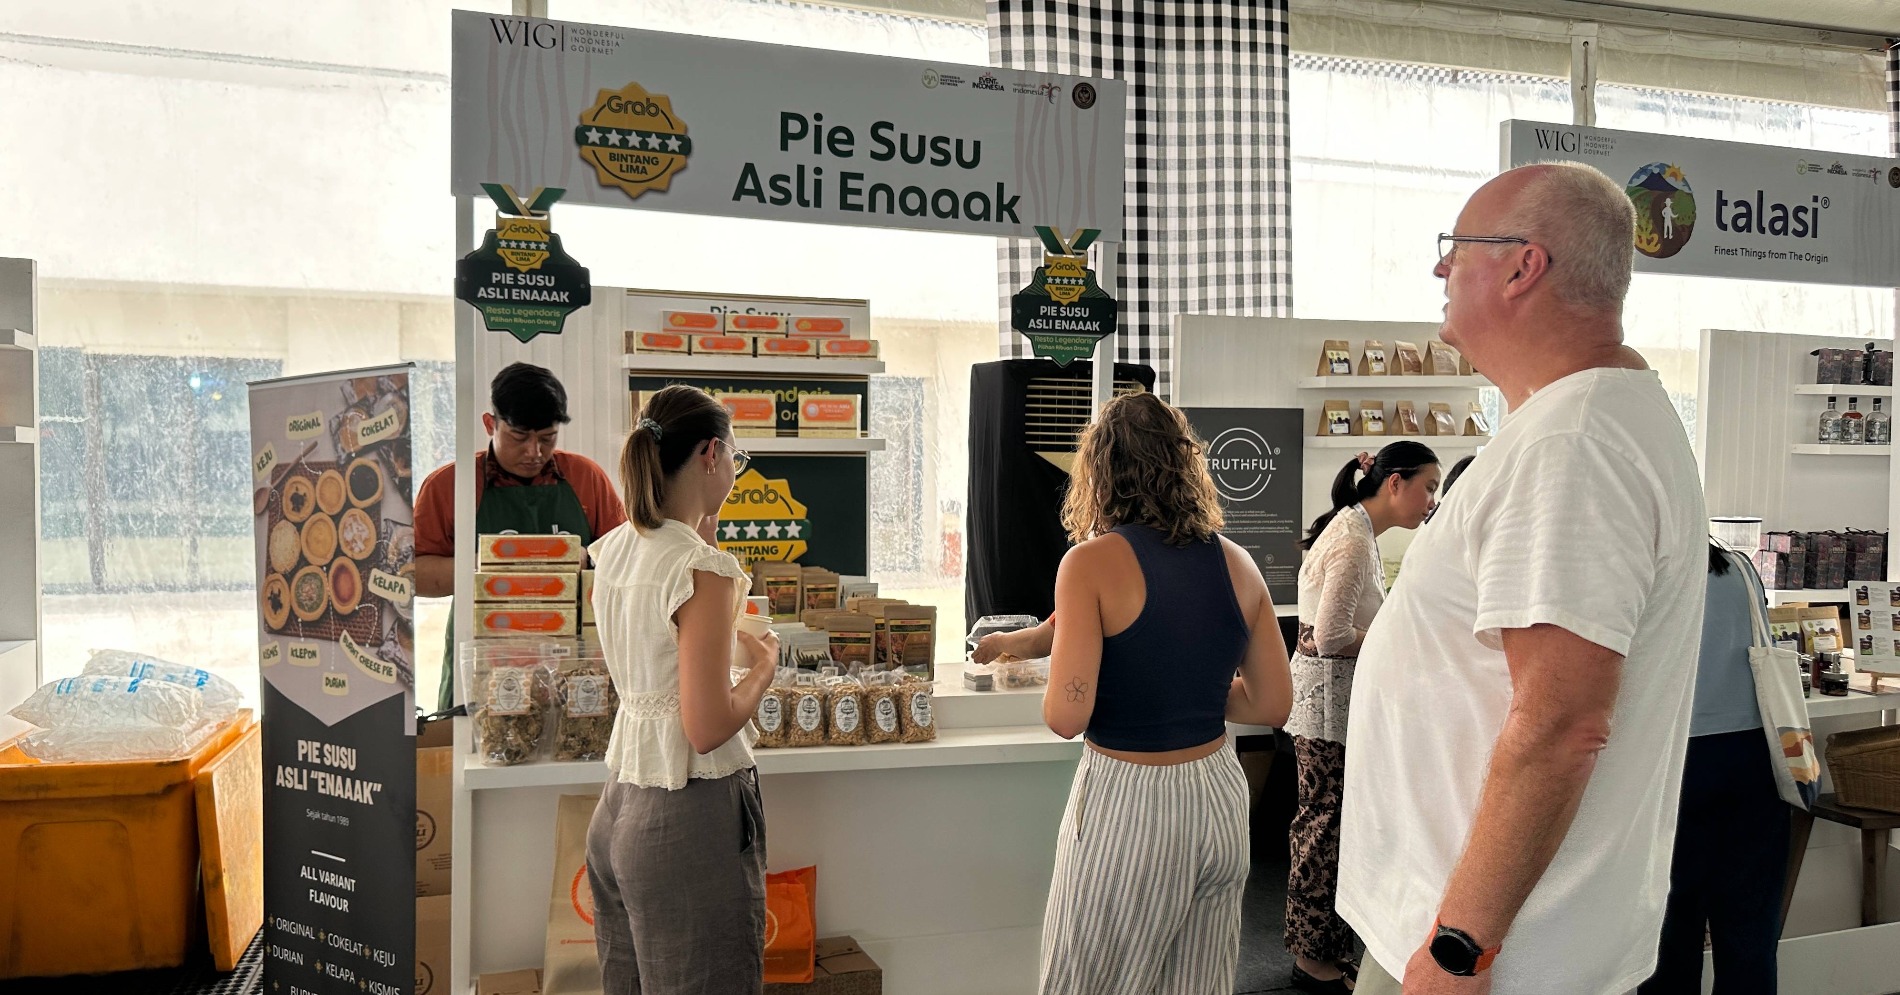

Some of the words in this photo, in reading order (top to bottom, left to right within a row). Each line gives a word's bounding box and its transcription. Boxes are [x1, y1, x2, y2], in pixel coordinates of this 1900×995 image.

[490, 18, 556, 49] WIG
[571, 28, 624, 40] WONDERFUL
[571, 36, 620, 47] INDONESIA
[571, 45, 614, 55] GOURMET
[972, 82, 1004, 92] INDONESIA
[1013, 87, 1044, 96] indonesia
[607, 96, 660, 117] Grab
[780, 112, 855, 158] Pie
[870, 121, 981, 169] Susu
[1535, 129, 1575, 152] WIG
[1584, 136, 1617, 144] WONDERFUL
[609, 153, 659, 166] BINTANG
[620, 164, 648, 175] LIMA
[732, 162, 823, 208] Asli
[840, 171, 1020, 224] Enaaak
[510, 224, 536, 234] Grab
[1714, 246, 1738, 256] Finest
[1740, 248, 1766, 259] Things
[1768, 250, 1786, 260] from
[1789, 252, 1803, 260] The
[1805, 253, 1828, 264] Origin
[1056, 262, 1075, 271] Grab
[492, 272, 514, 284] PIE
[518, 274, 555, 286] SUSU
[477, 287, 508, 299] ASLI
[512, 289, 569, 303] ENAAAK
[486, 306, 510, 315] Resto
[513, 308, 560, 317] Legendaris
[1040, 306, 1058, 316] PIE
[1060, 307, 1089, 318] SUSU
[1028, 318, 1052, 329] ASLI
[1055, 320, 1100, 332] ENAAAK
[1055, 337, 1093, 345] Legendaris
[361, 415, 395, 437] COKELAT
[256, 450, 272, 472] KEJU
[1204, 458, 1276, 471] TRUTHFUL
[726, 484, 778, 504] Grab
[726, 546, 778, 555] BINTANG
[373, 575, 405, 594] KELAPA
[359, 655, 381, 673] CHEESE
[298, 740, 320, 764] PIE
[323, 743, 356, 771] SUSU
[276, 765, 308, 791] ASLI
[306, 808, 320, 820] Sejak
[322, 812, 336, 823] tahun
[337, 816, 349, 826] 1989
[301, 865, 317, 880] ALL
[319, 869, 356, 892] VARIANT
[310, 889, 349, 912] FLAVOUR
[276, 918, 315, 940] ORIGINAL
[328, 933, 363, 956] COKELAT
[373, 949, 396, 967] KEJU
[272, 944, 304, 966] DURIAN
[326, 962, 355, 984] KELAPA
[369, 980, 400, 995] KISMIS
